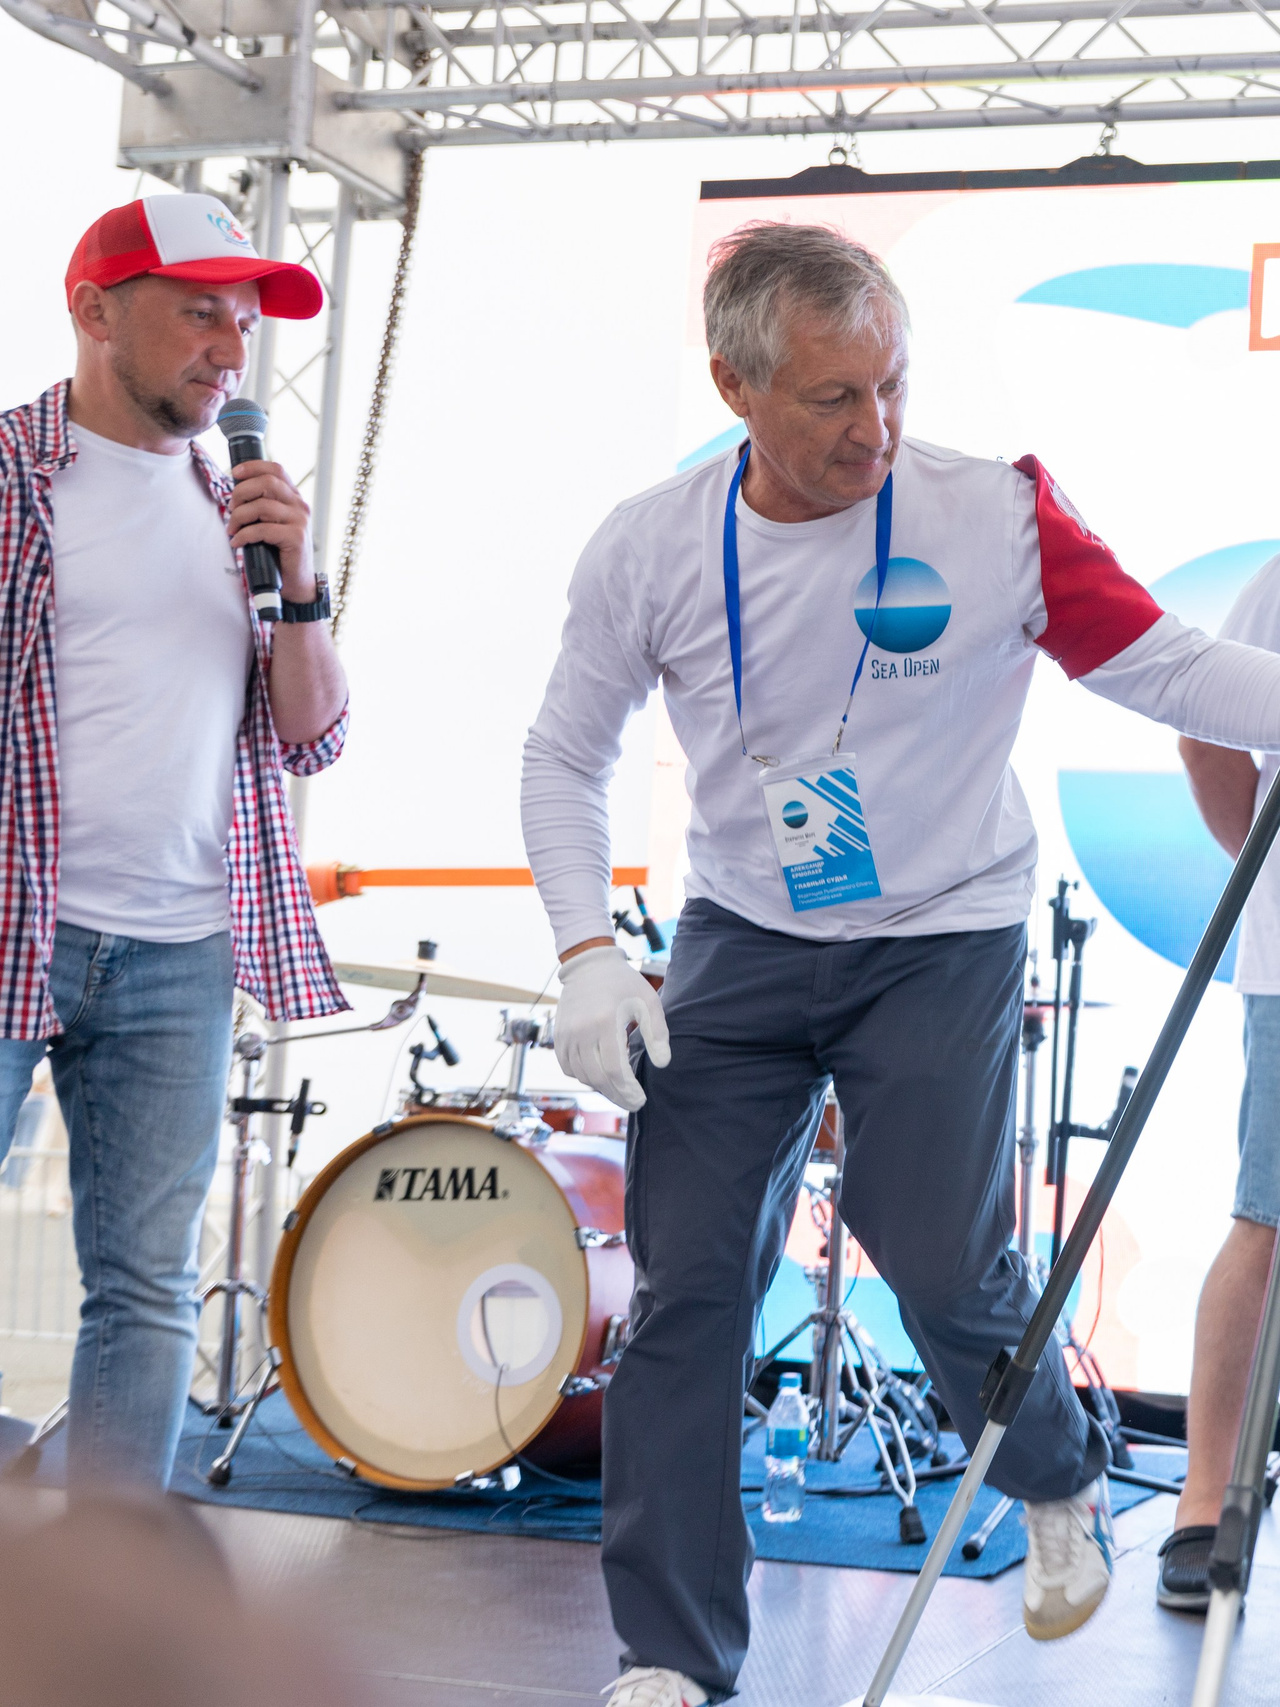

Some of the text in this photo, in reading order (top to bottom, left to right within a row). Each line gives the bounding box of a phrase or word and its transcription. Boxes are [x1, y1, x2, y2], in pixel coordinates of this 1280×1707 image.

[794, 874, 848, 890] ГЛАВНЫЙ СУДЬЯ
[398, 1167, 499, 1201] TAMA
